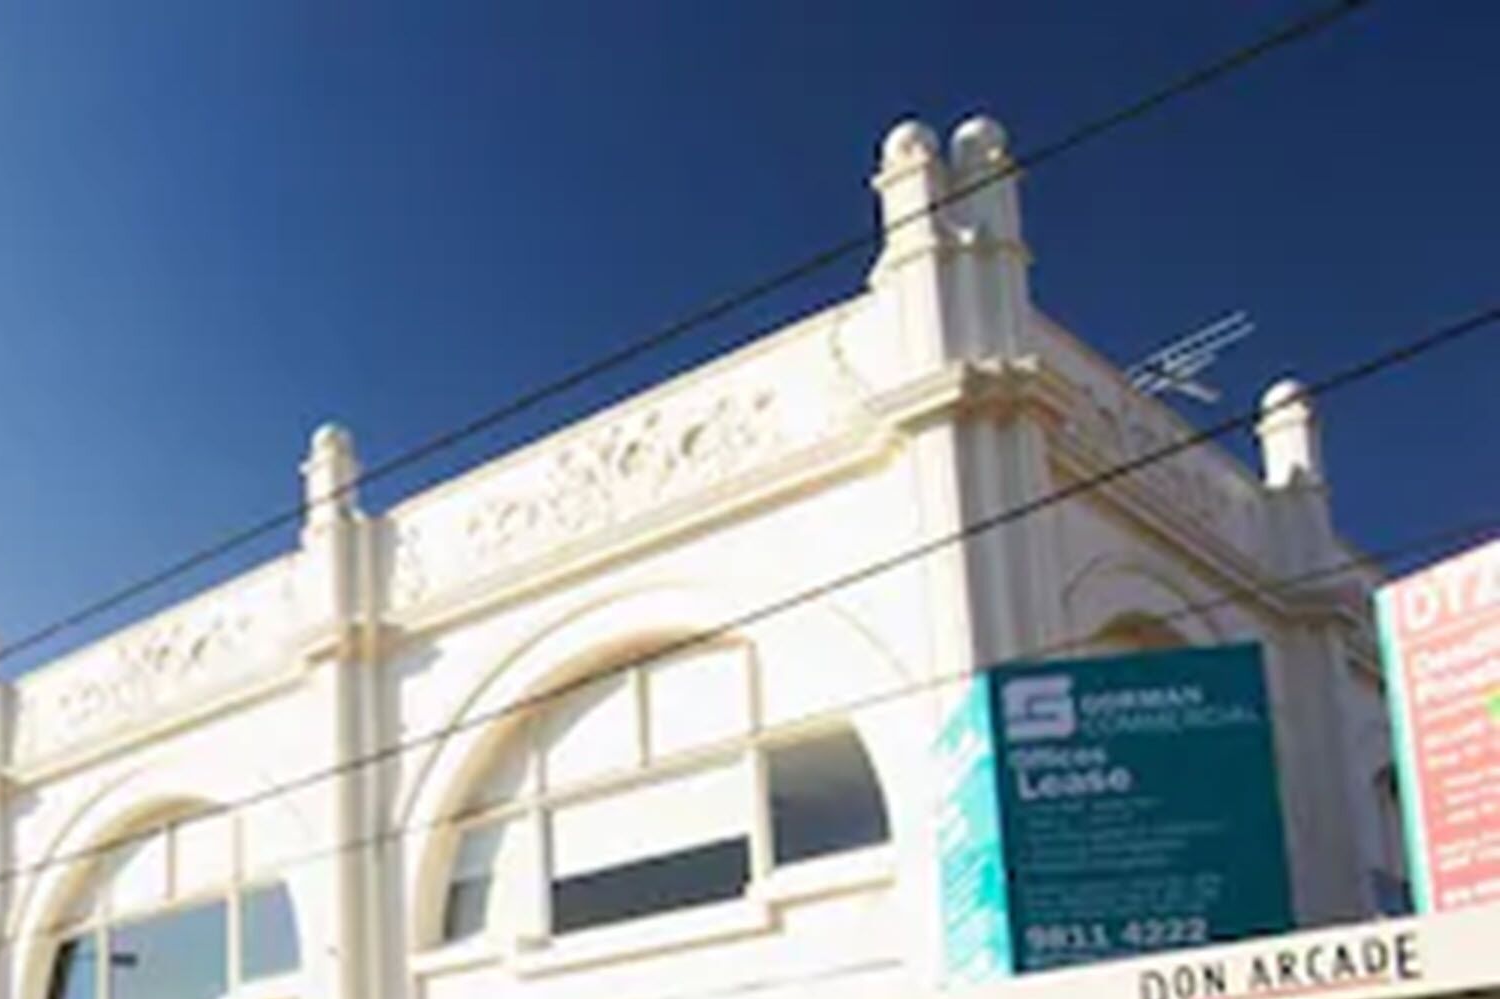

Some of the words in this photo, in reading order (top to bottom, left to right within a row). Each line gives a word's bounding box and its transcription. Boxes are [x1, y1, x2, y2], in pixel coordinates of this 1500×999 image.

[1018, 765, 1132, 801] Lease
[1120, 917, 1209, 944] 4222
[1248, 931, 1423, 987] ARCADE
